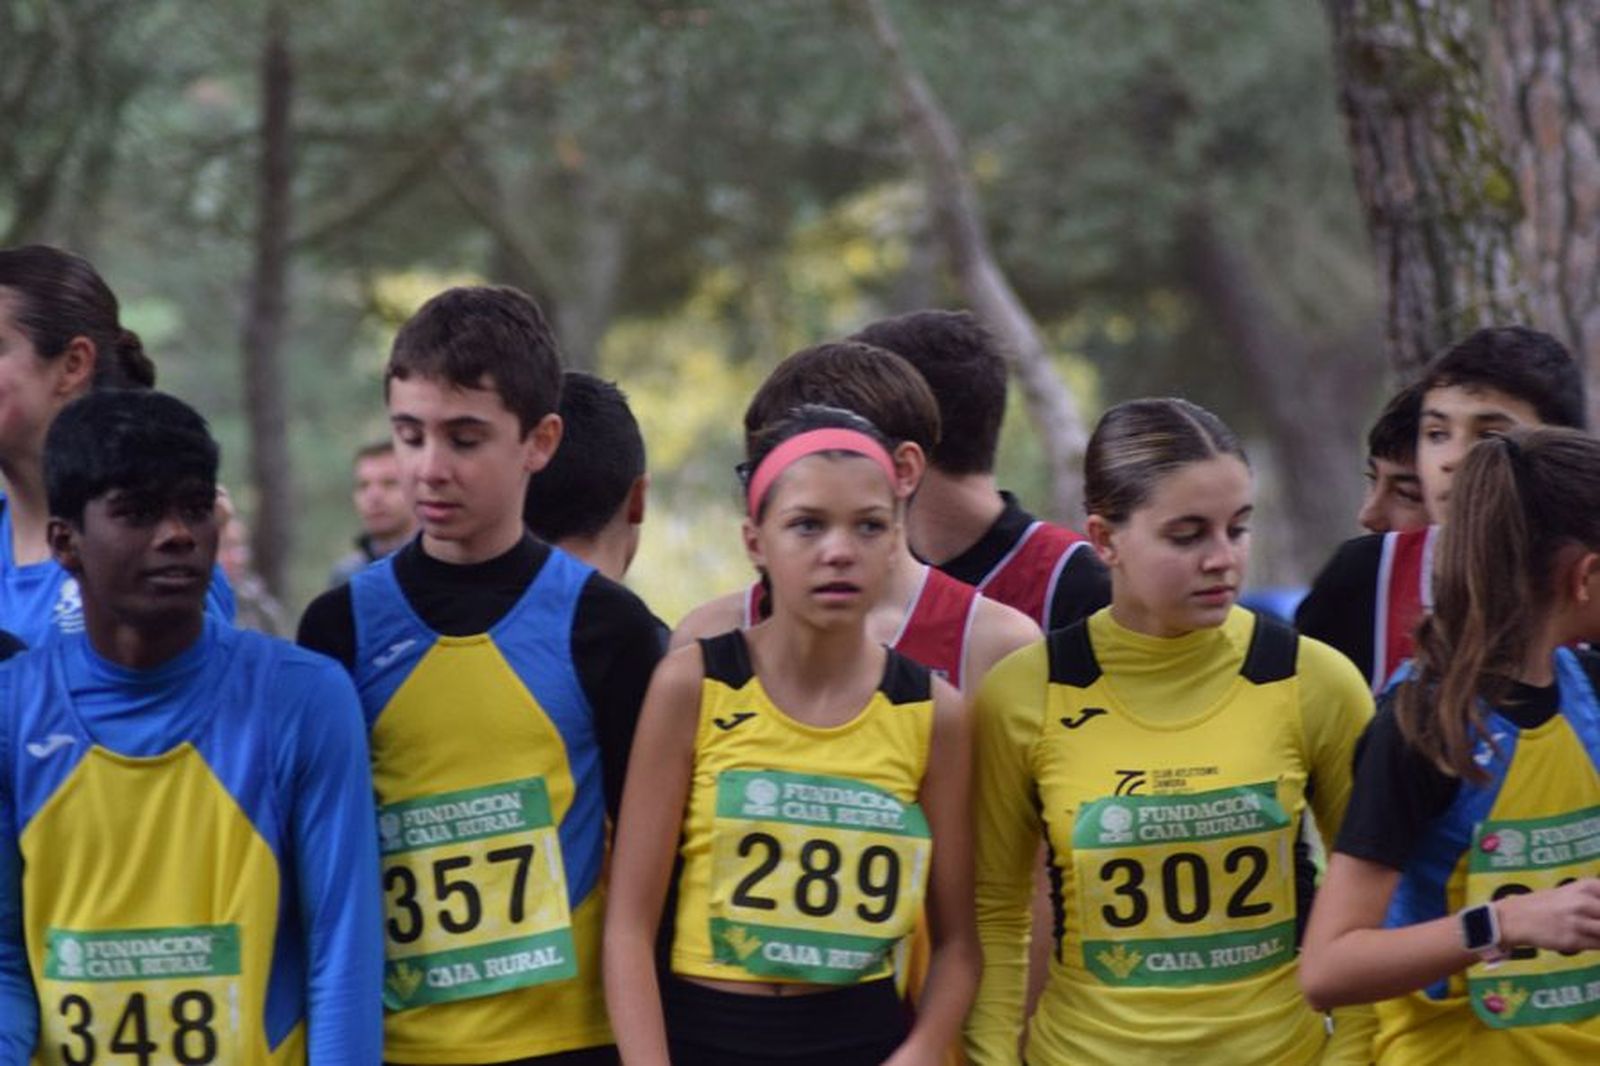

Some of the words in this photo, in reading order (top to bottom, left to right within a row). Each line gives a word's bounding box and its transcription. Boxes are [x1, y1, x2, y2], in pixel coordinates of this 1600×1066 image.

[405, 824, 453, 846] CAJA
[457, 811, 526, 836] RURAL
[782, 801, 832, 821] CAJA
[835, 806, 905, 830] RURAL
[1140, 822, 1190, 841] CAJA
[1195, 813, 1264, 836] RURAL
[382, 844, 534, 944] 357
[731, 832, 901, 923] 289
[1100, 846, 1273, 928] 302
[86, 959, 136, 977] CAJA
[141, 956, 213, 975] RURAL
[427, 962, 481, 987] CAJA
[485, 946, 564, 979] RURAL
[763, 941, 823, 966] CAJA
[1146, 952, 1207, 971] CAJA
[1212, 939, 1285, 966] RURAL
[59, 990, 217, 1066] 348
